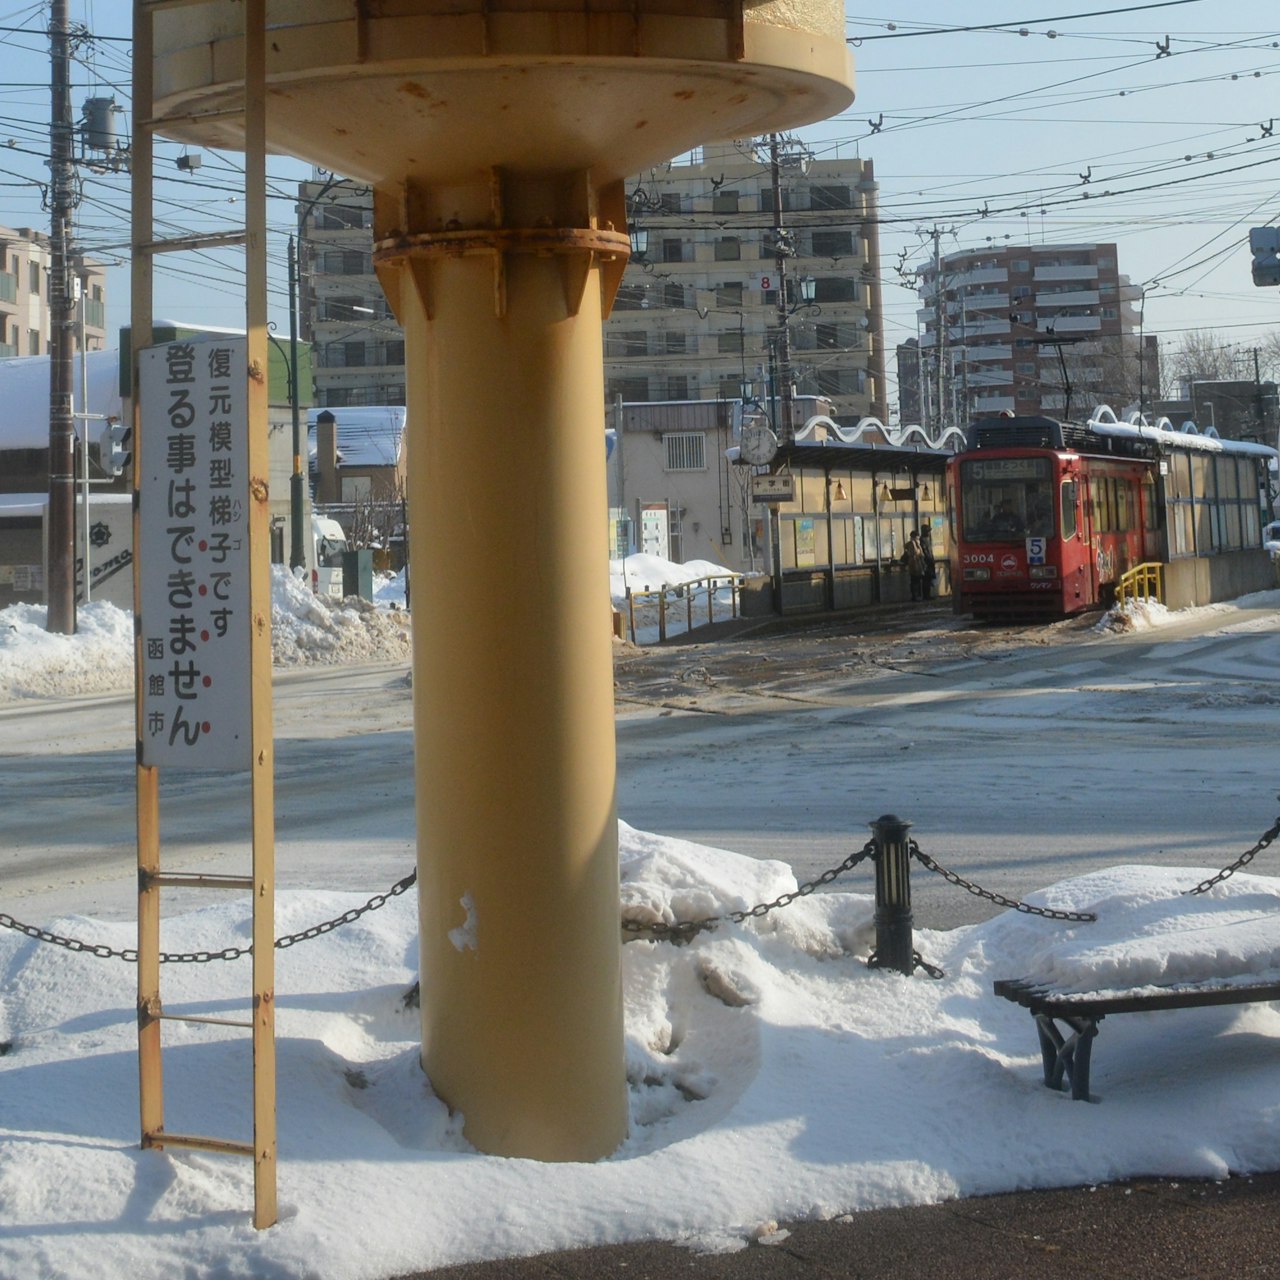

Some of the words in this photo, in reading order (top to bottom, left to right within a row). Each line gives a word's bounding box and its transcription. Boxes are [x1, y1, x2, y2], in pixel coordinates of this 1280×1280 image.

[972, 463, 984, 479] 5
[754, 479, 790, 488] 十字街
[207, 347, 235, 639] 復元模型梯子です
[163, 343, 202, 748] 登る事はできません
[1029, 538, 1043, 556] 5
[963, 553, 995, 564] 3004
[146, 636, 165, 738] 函館市
